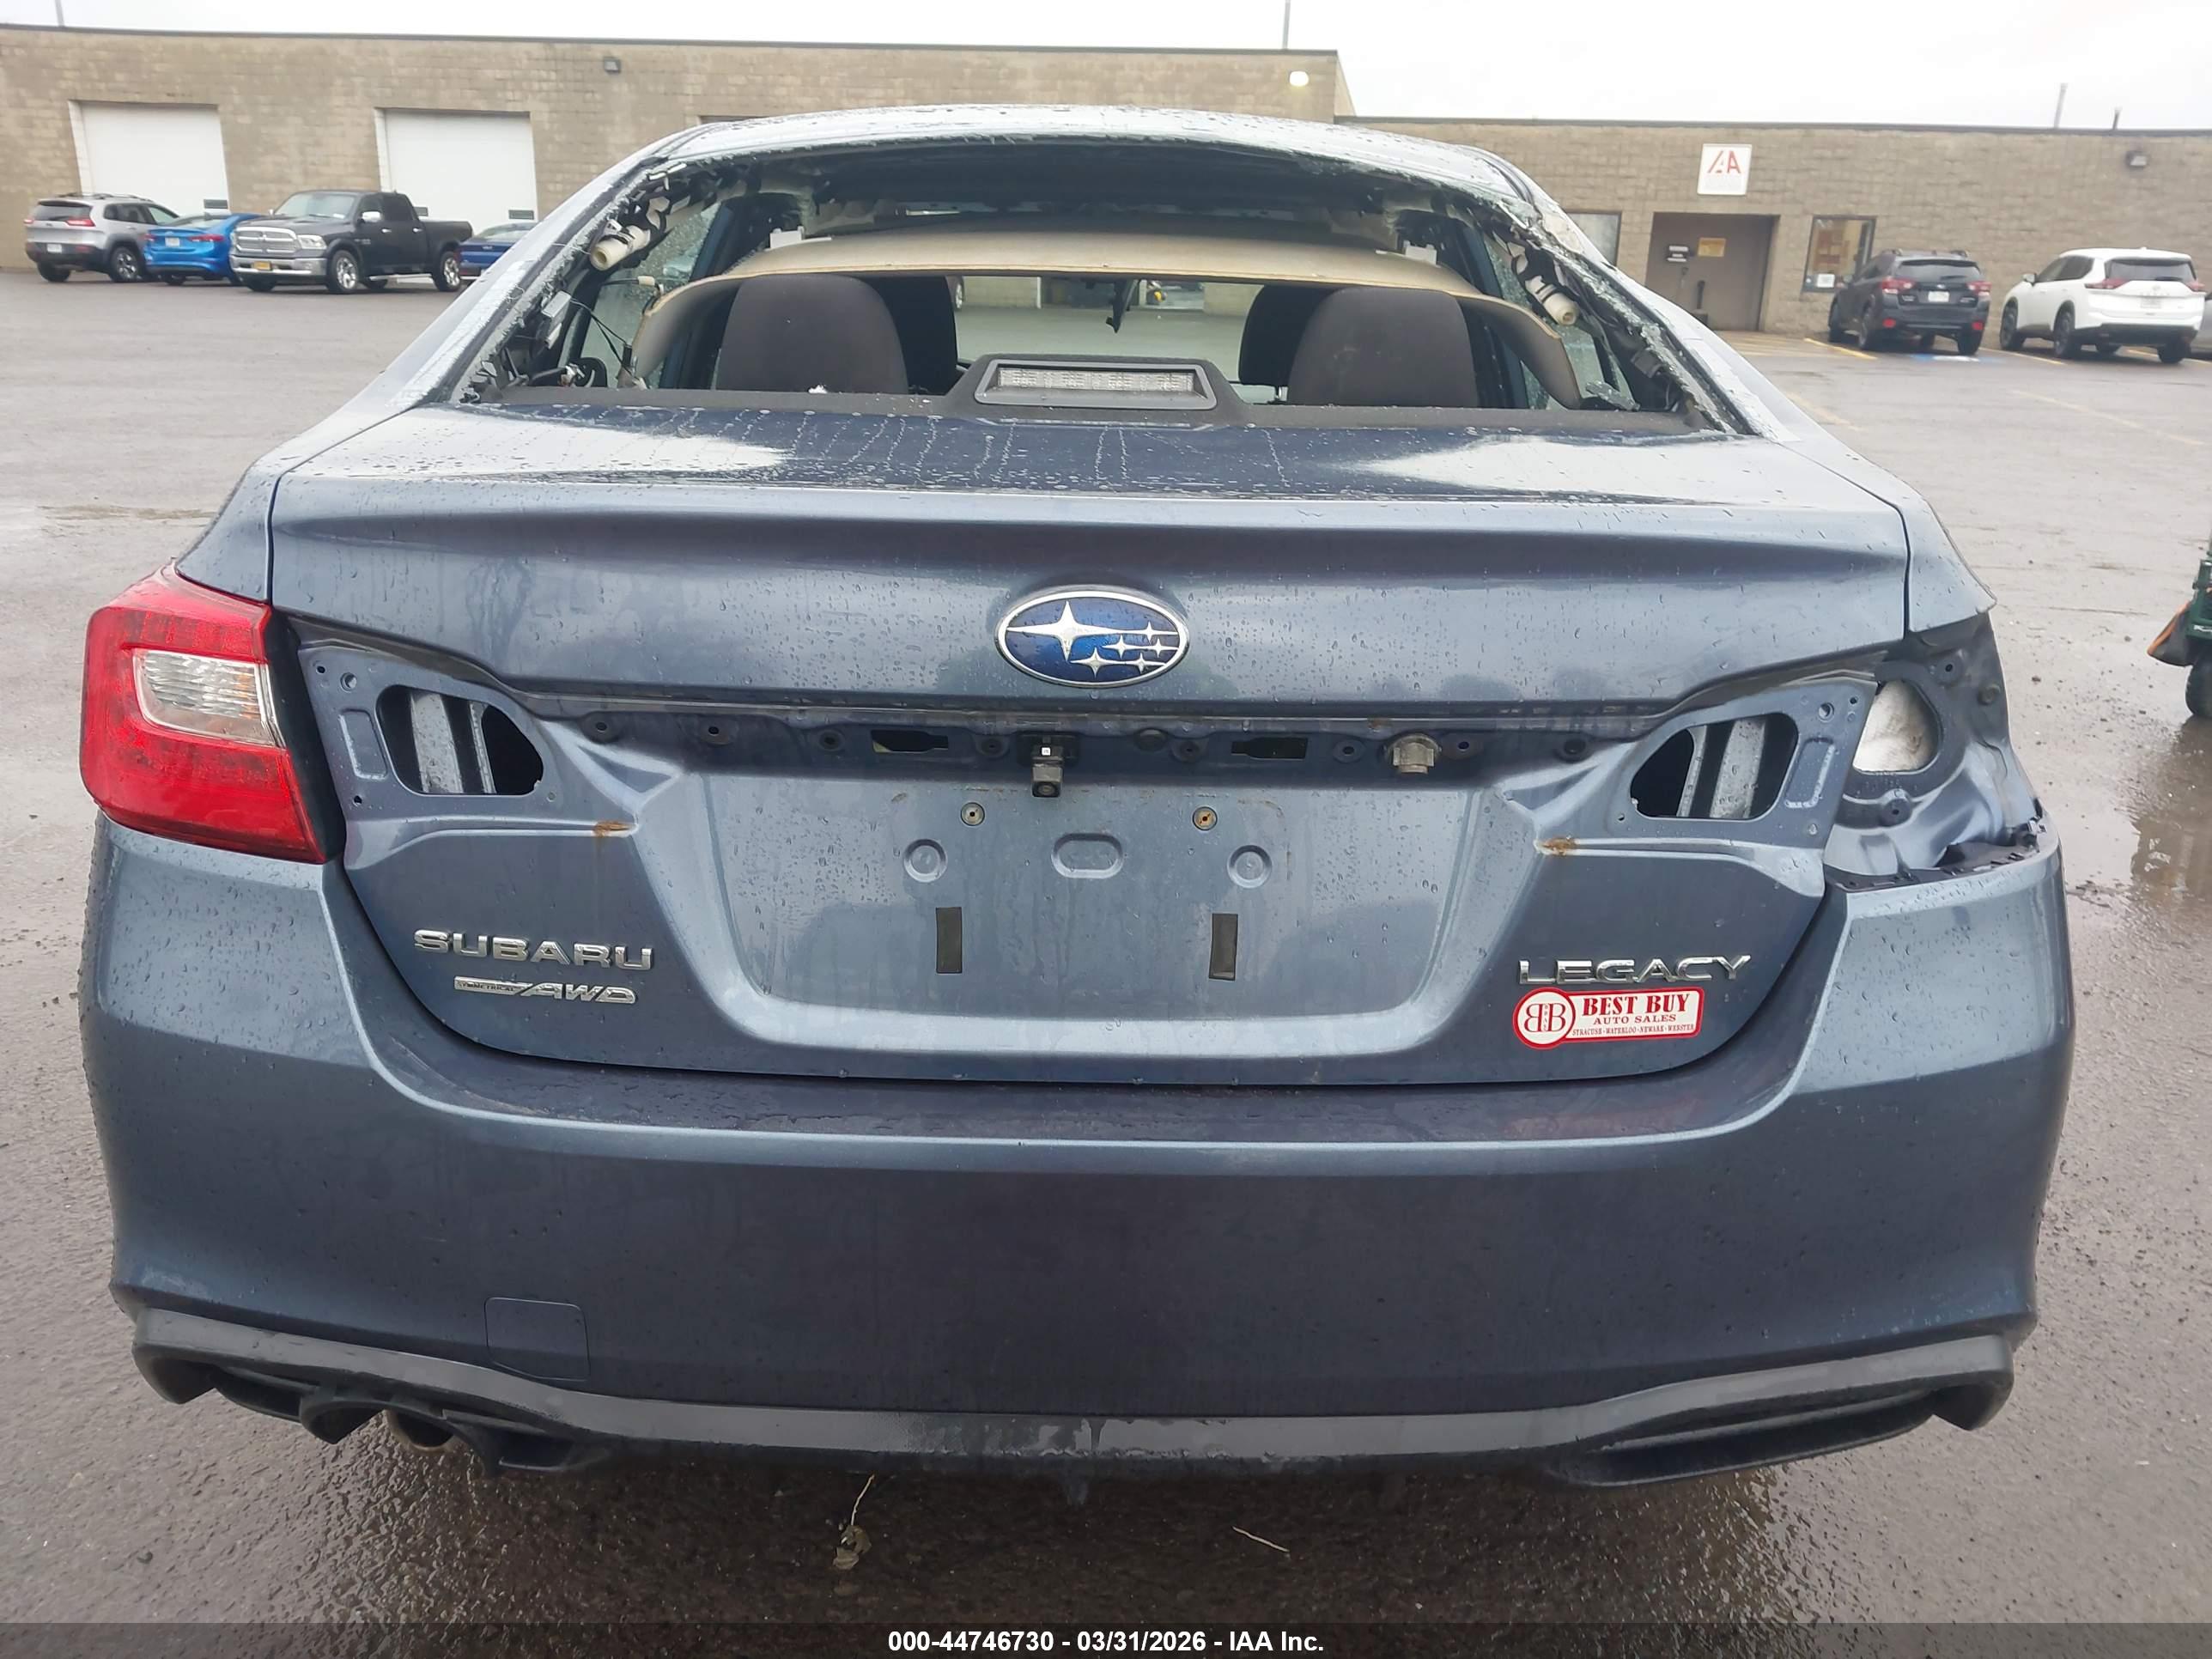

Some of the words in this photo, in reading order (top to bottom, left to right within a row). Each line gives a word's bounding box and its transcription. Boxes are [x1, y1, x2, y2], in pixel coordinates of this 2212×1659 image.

[413, 928, 655, 971] SUBARU
[1518, 955, 1752, 985] LEGACY
[520, 982, 636, 1004] AWD
[1583, 996, 1638, 1017] BEST
[1647, 994, 1690, 1012] BUY
[1594, 1016, 1628, 1025] AUTO
[1634, 1013, 1677, 1024] SALES
